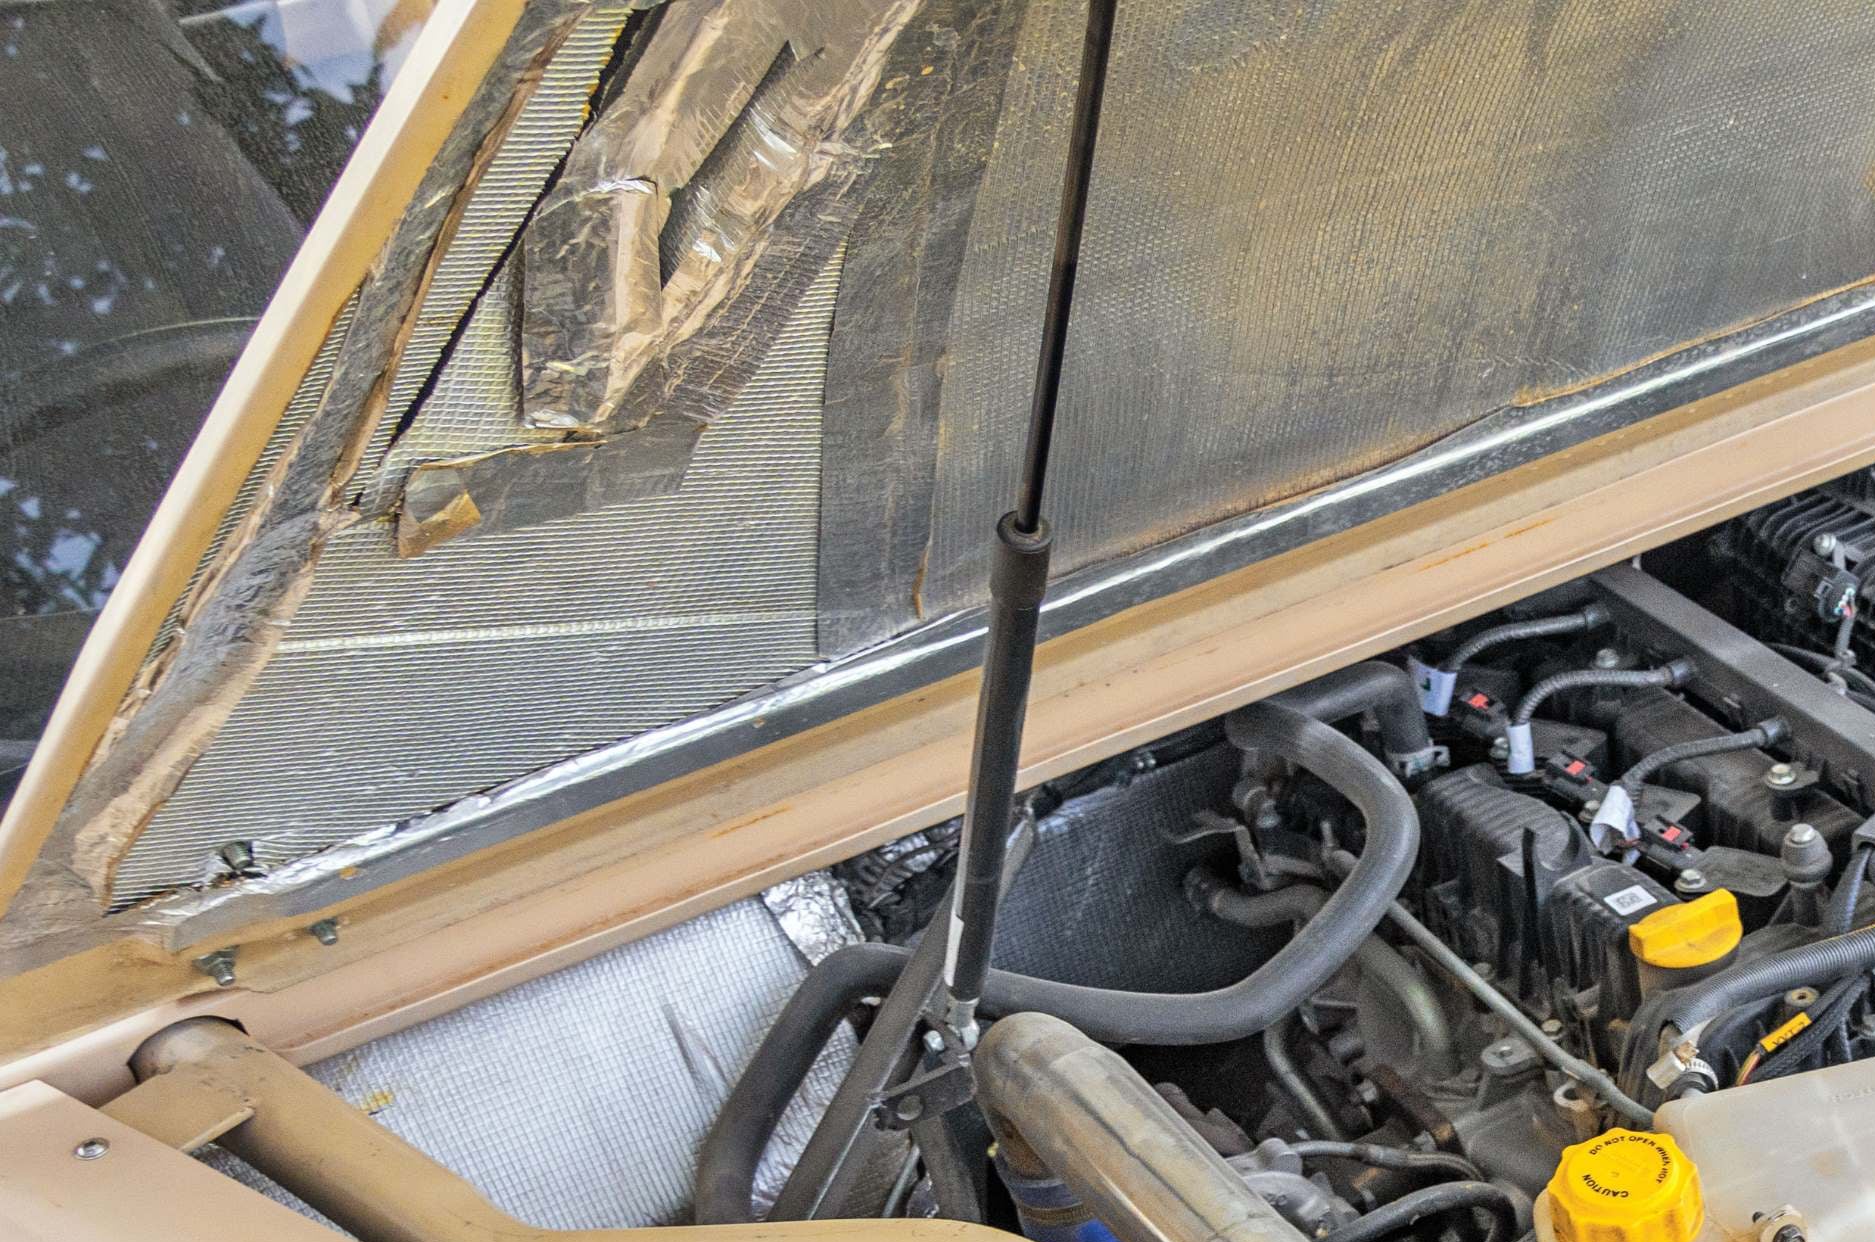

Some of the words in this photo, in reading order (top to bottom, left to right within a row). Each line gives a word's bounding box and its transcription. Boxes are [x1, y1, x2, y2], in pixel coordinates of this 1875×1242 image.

[1604, 1135, 1625, 1147] NOT
[1628, 1135, 1657, 1147] OPEN
[1589, 1144, 1603, 1156] DO
[1655, 1146, 1671, 1167] WHEN
[1655, 1167, 1669, 1184] HOT
[1582, 1173, 1630, 1198] CAUTION
